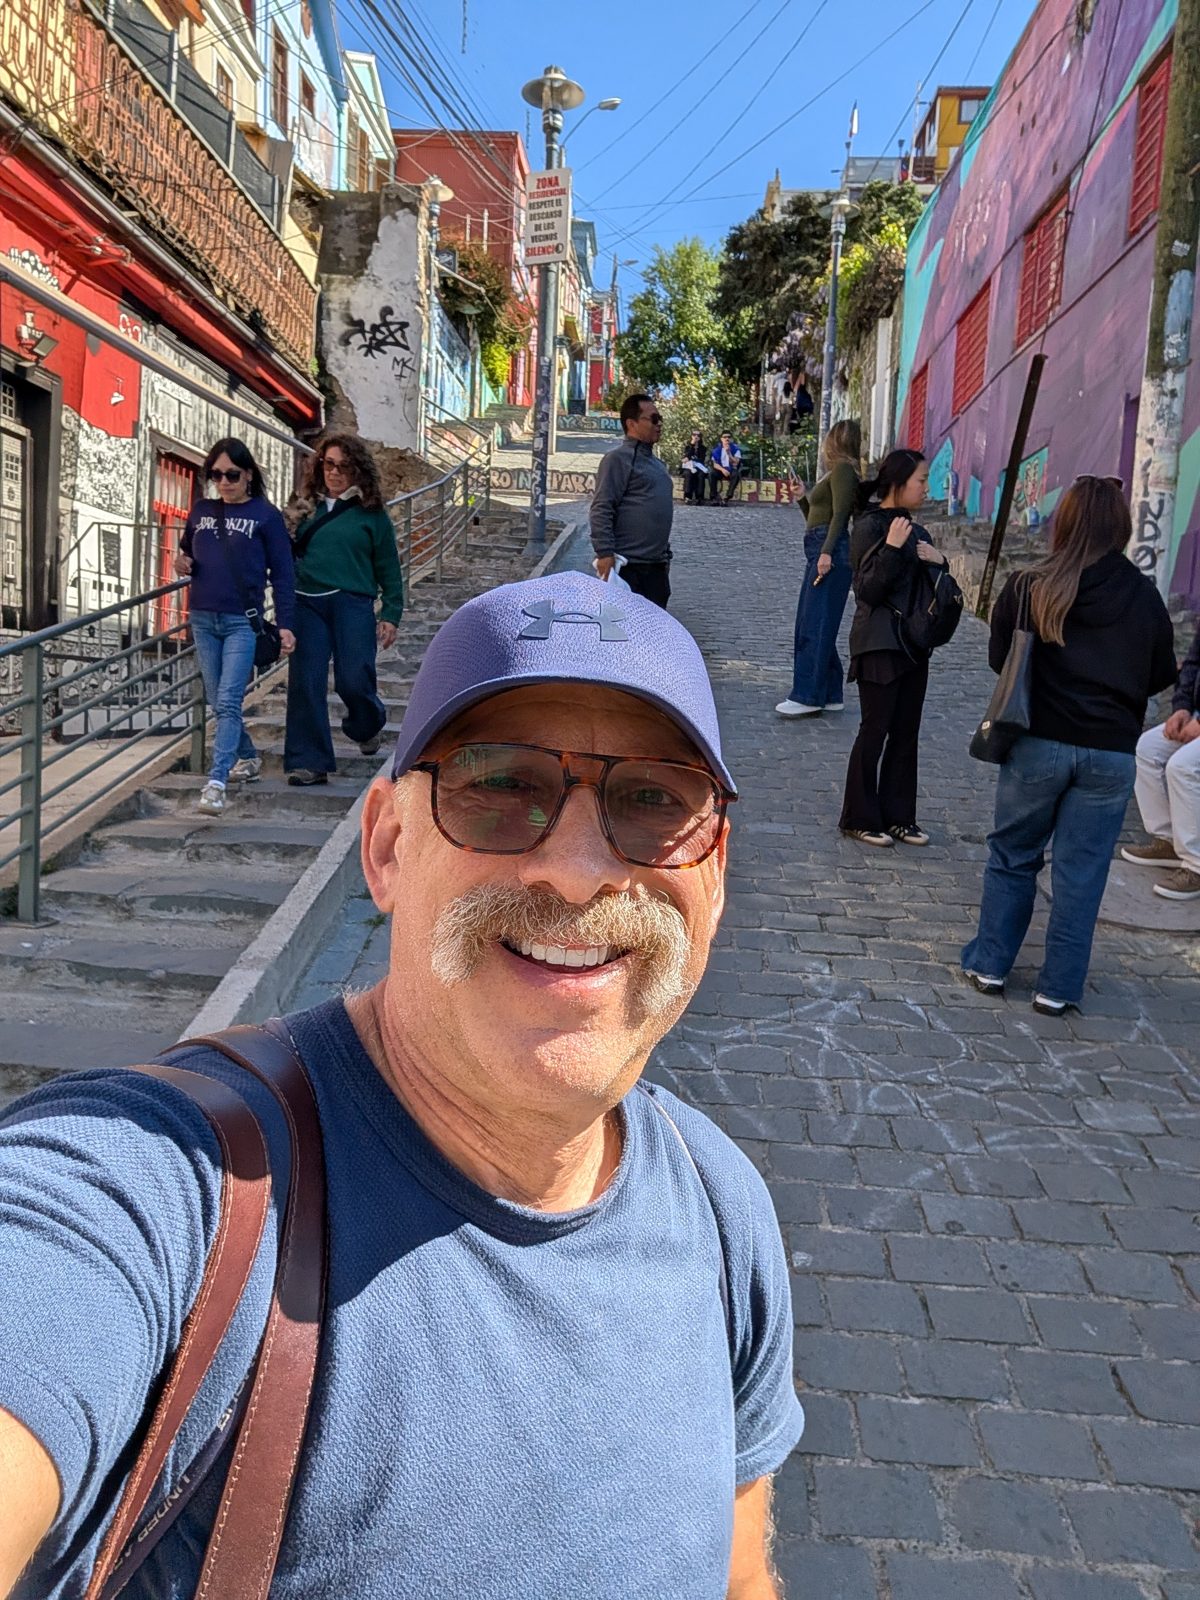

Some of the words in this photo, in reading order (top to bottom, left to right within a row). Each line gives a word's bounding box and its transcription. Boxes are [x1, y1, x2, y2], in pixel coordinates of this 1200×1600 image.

[537, 176, 559, 189] ZONA
[529, 188, 566, 199] RESIDENCIAL
[529, 199, 554, 210] RESPETE
[555, 198, 563, 207] EL
[529, 210, 562, 221] DESCANSO
[534, 223, 542, 232] DE
[544, 222, 555, 231] LOS
[531, 233, 557, 243] VECINOS
